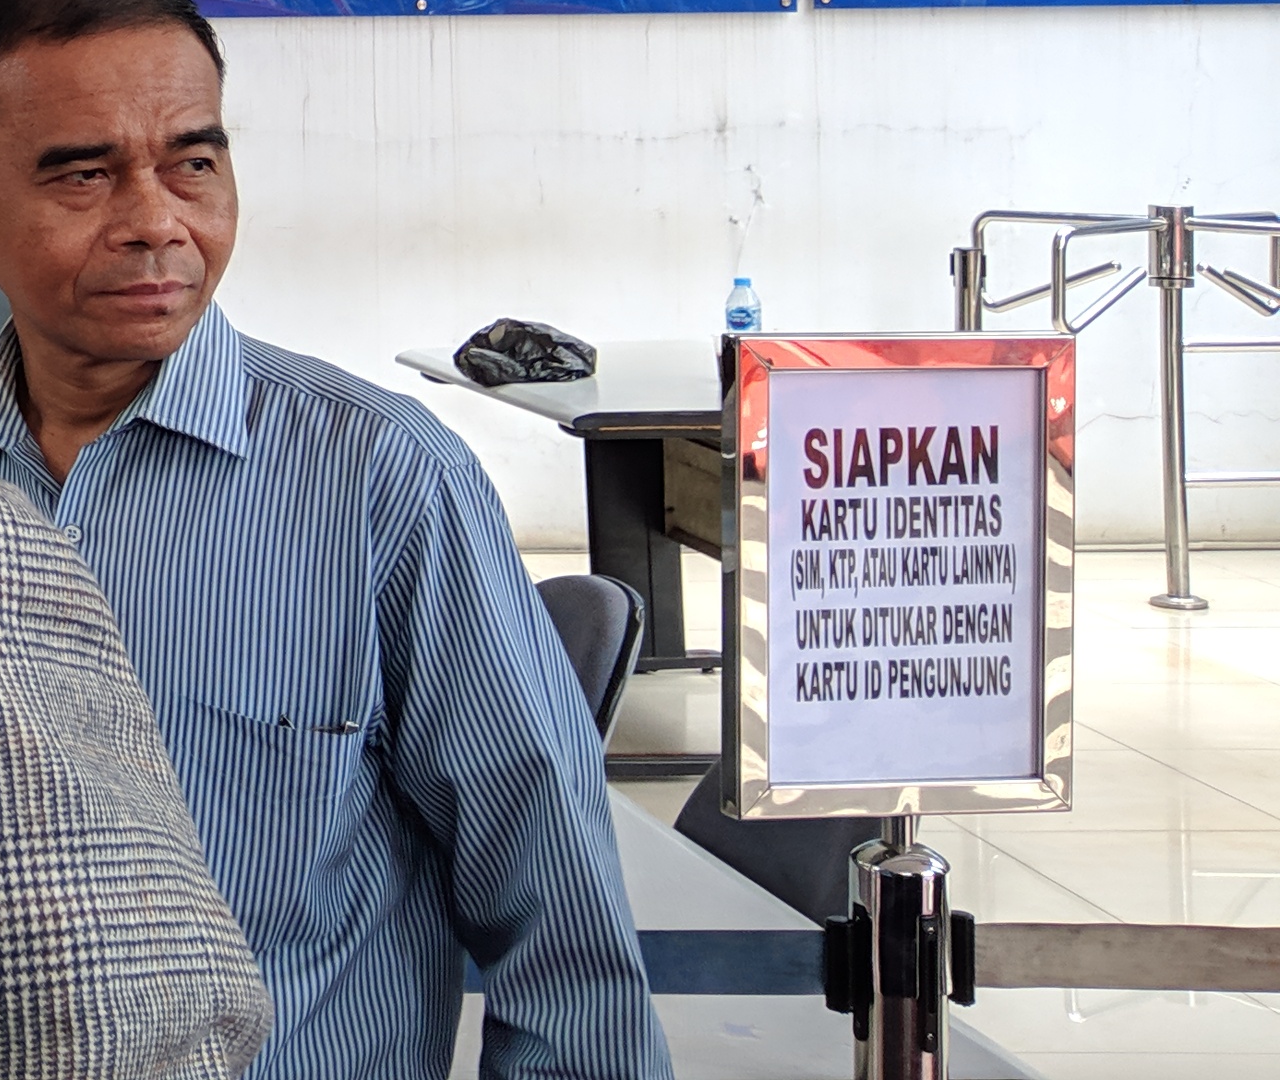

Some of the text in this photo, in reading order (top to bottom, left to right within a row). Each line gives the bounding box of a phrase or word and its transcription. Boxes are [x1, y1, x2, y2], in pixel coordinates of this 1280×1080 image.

[803, 425, 1000, 489] SIAPKAN
[801, 494, 1002, 541] KARTU IDENTITAS
[791, 542, 1017, 601] (SIM, KTP, ATAU KARTU LAINNYA)
[795, 603, 1013, 650] UNTUK DITUKAR DENGAN
[795, 655, 1012, 703] KARTU ID PENGUNJUNG
